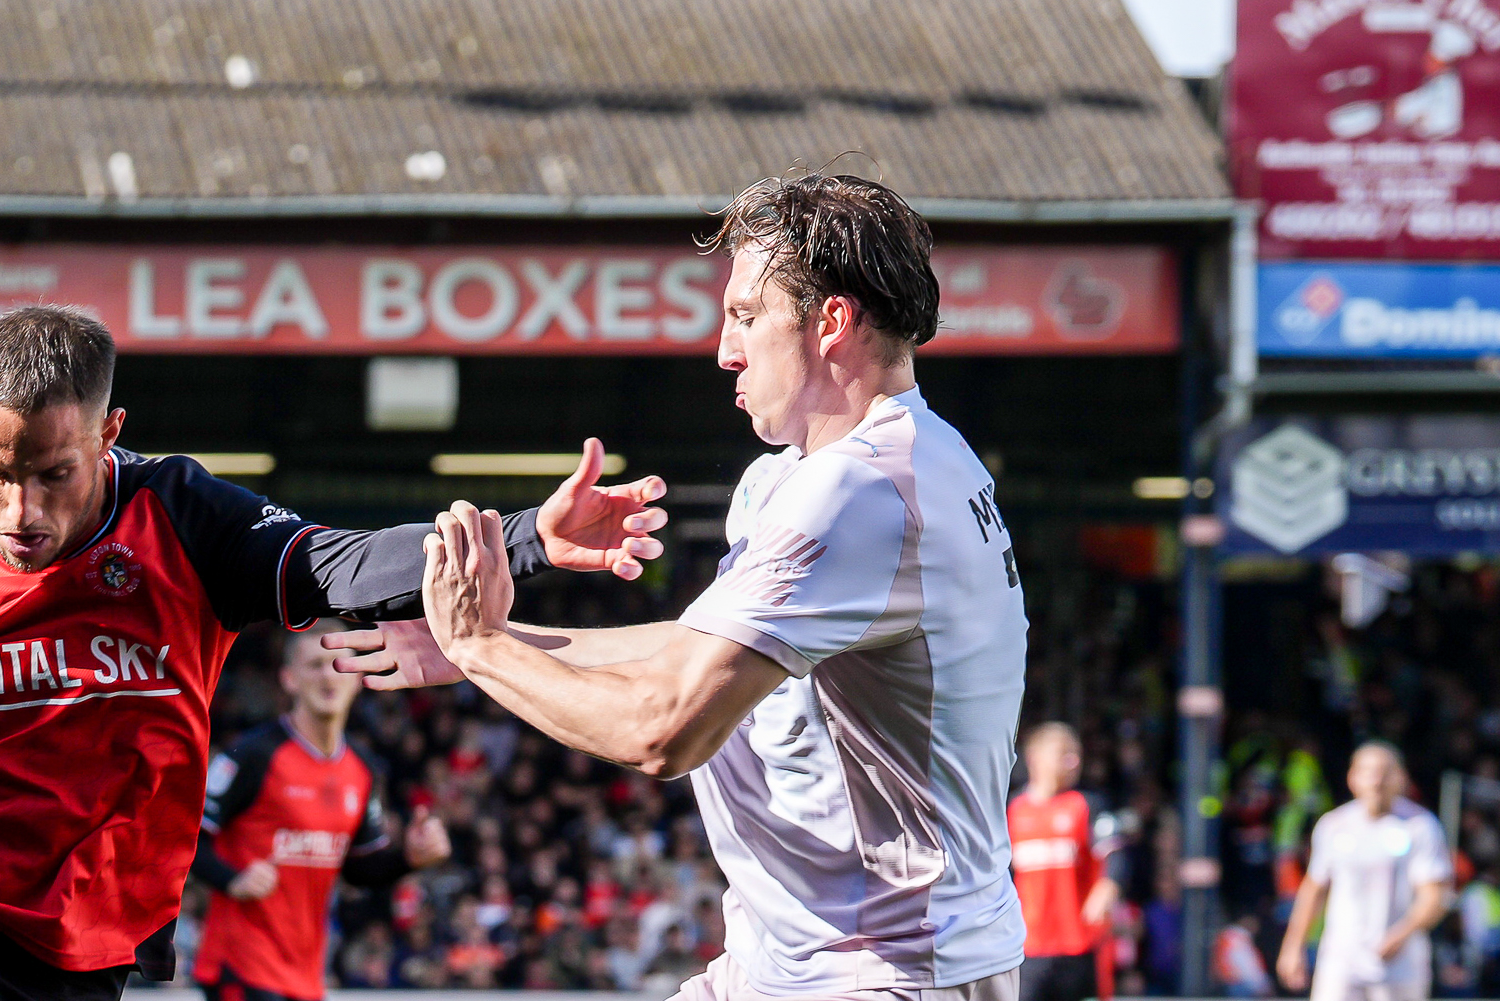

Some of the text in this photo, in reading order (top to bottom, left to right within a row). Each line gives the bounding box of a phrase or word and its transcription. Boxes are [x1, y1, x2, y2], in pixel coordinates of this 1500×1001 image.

[129, 257, 718, 344] LEA BOXES
[112, 542, 134, 558] TOWN
[90, 635, 170, 684] SKY
